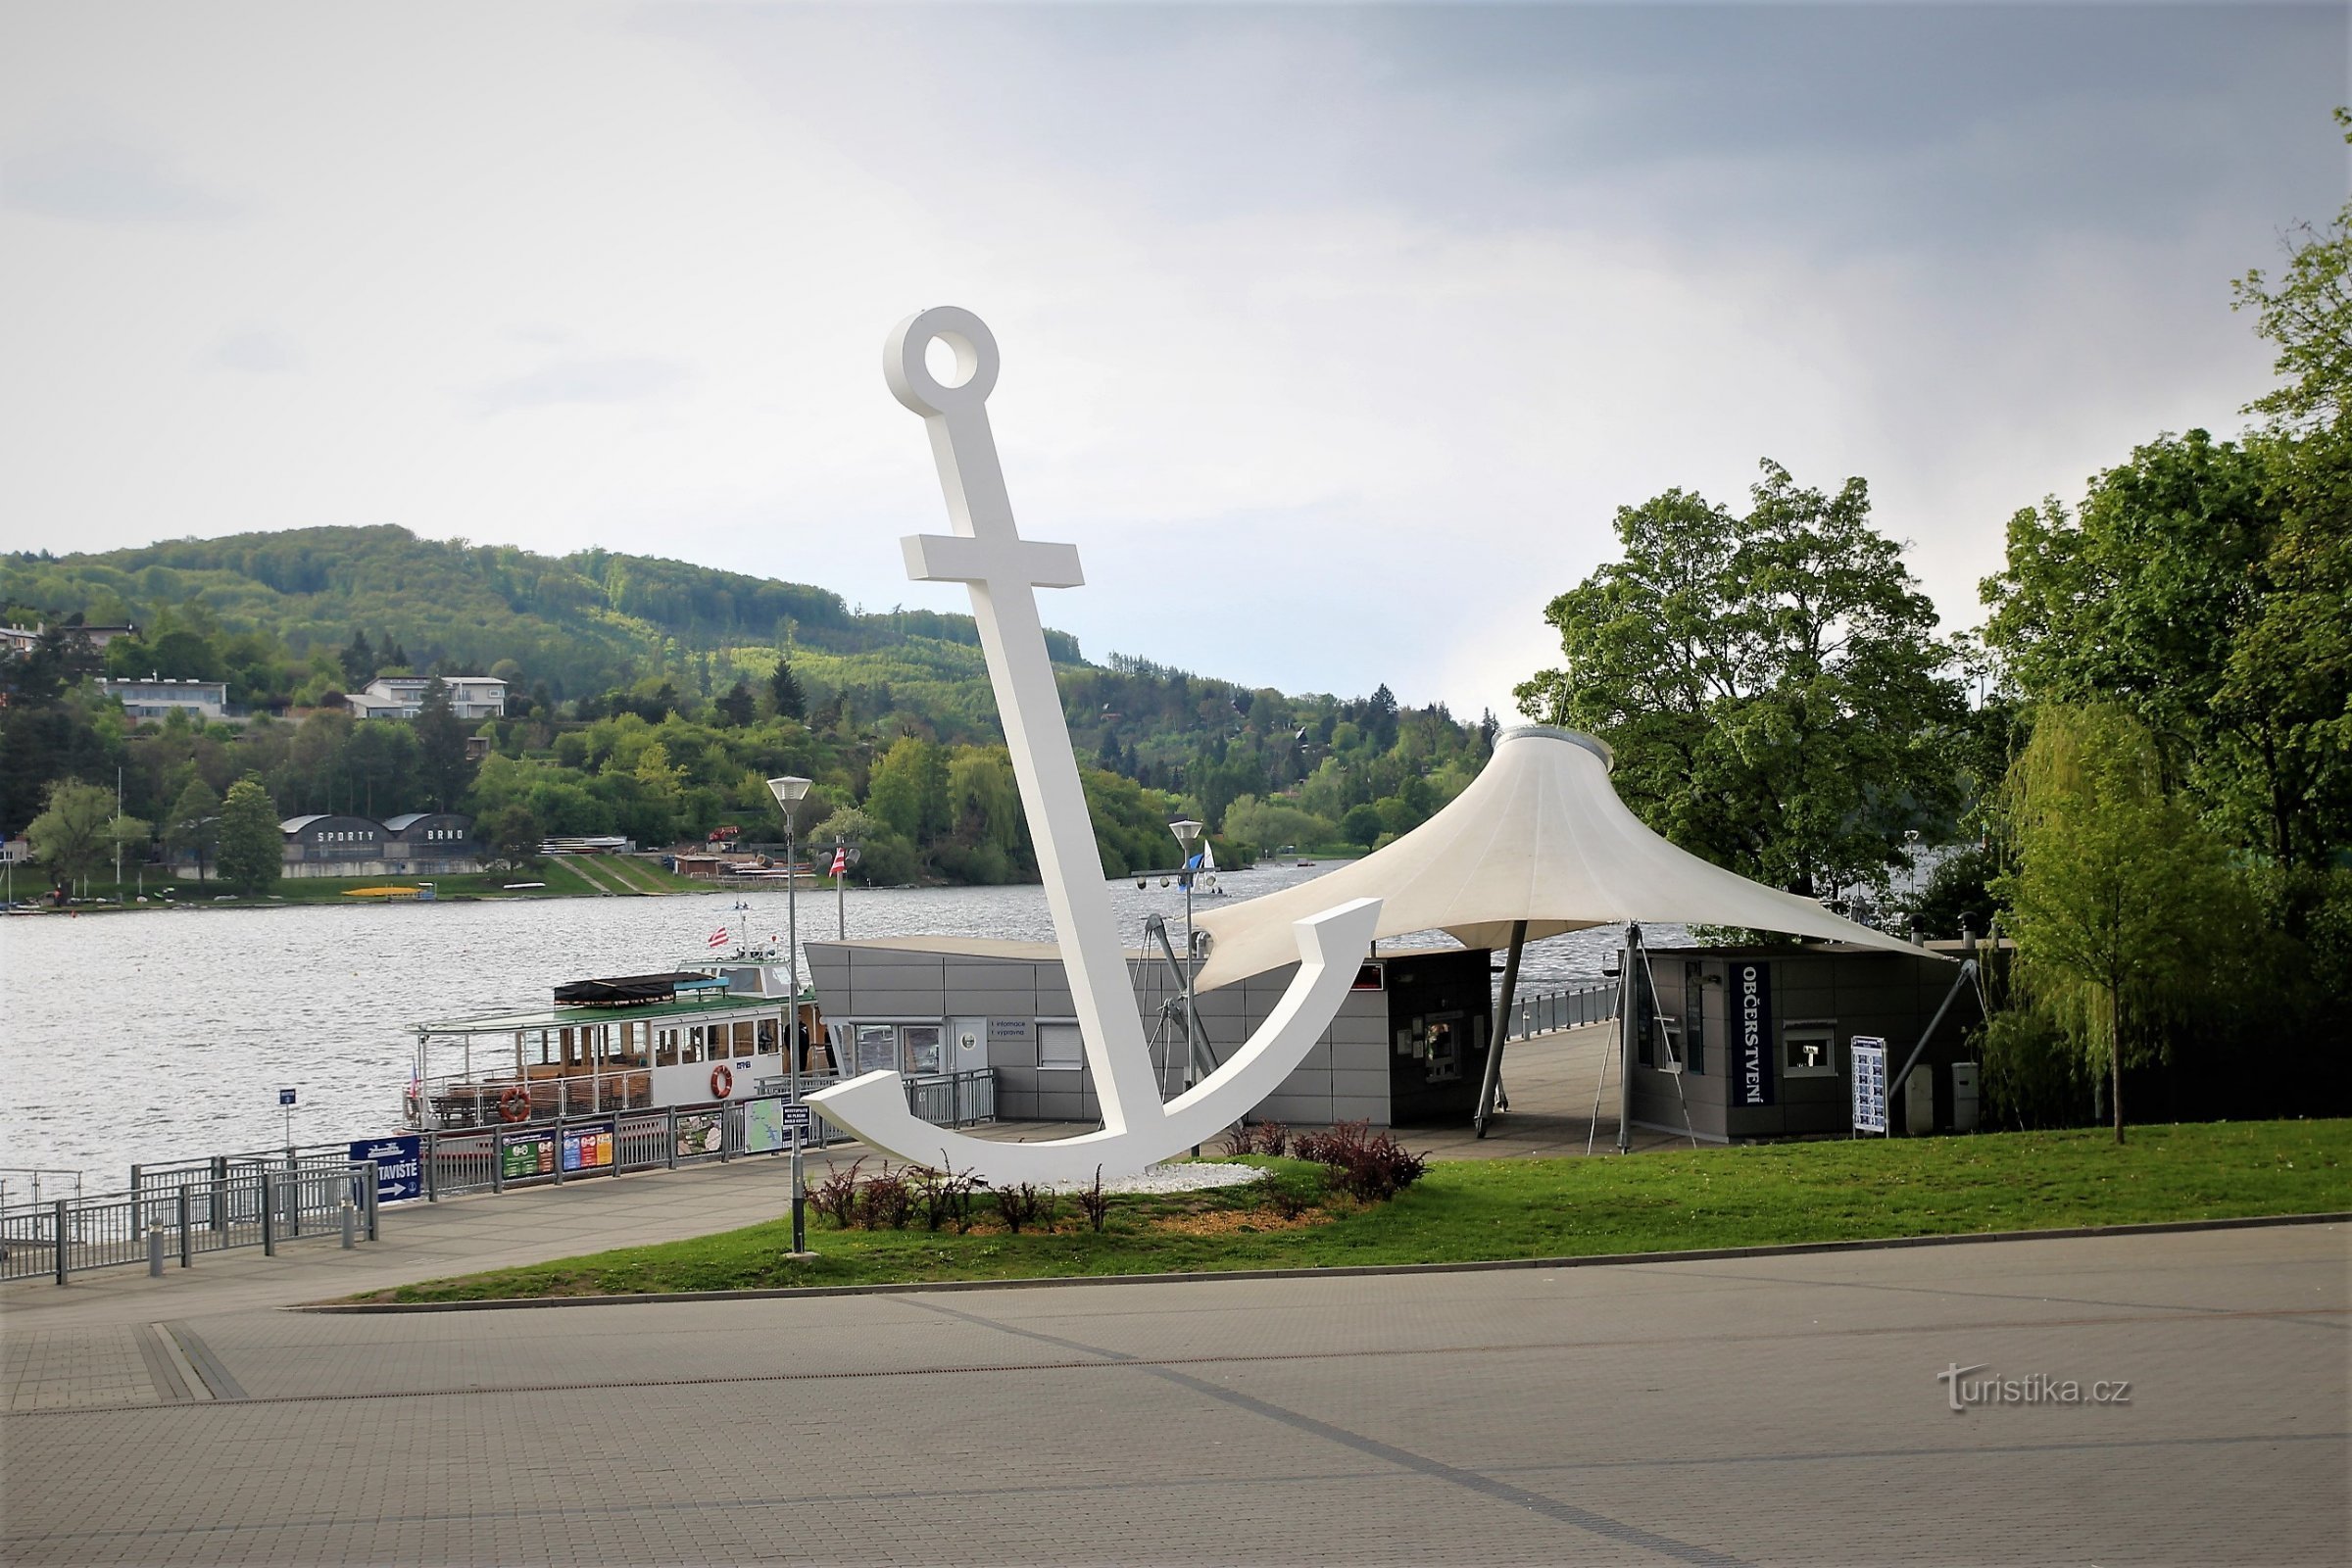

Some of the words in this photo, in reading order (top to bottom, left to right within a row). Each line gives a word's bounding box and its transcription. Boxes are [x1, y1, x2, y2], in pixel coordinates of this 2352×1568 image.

[318, 831, 374, 842] SPORTY
[427, 830, 463, 840] BRNO
[1742, 966, 1764, 1103] OBČERSTVENÍ
[378, 1157, 418, 1181] TAVIŠTĚ
